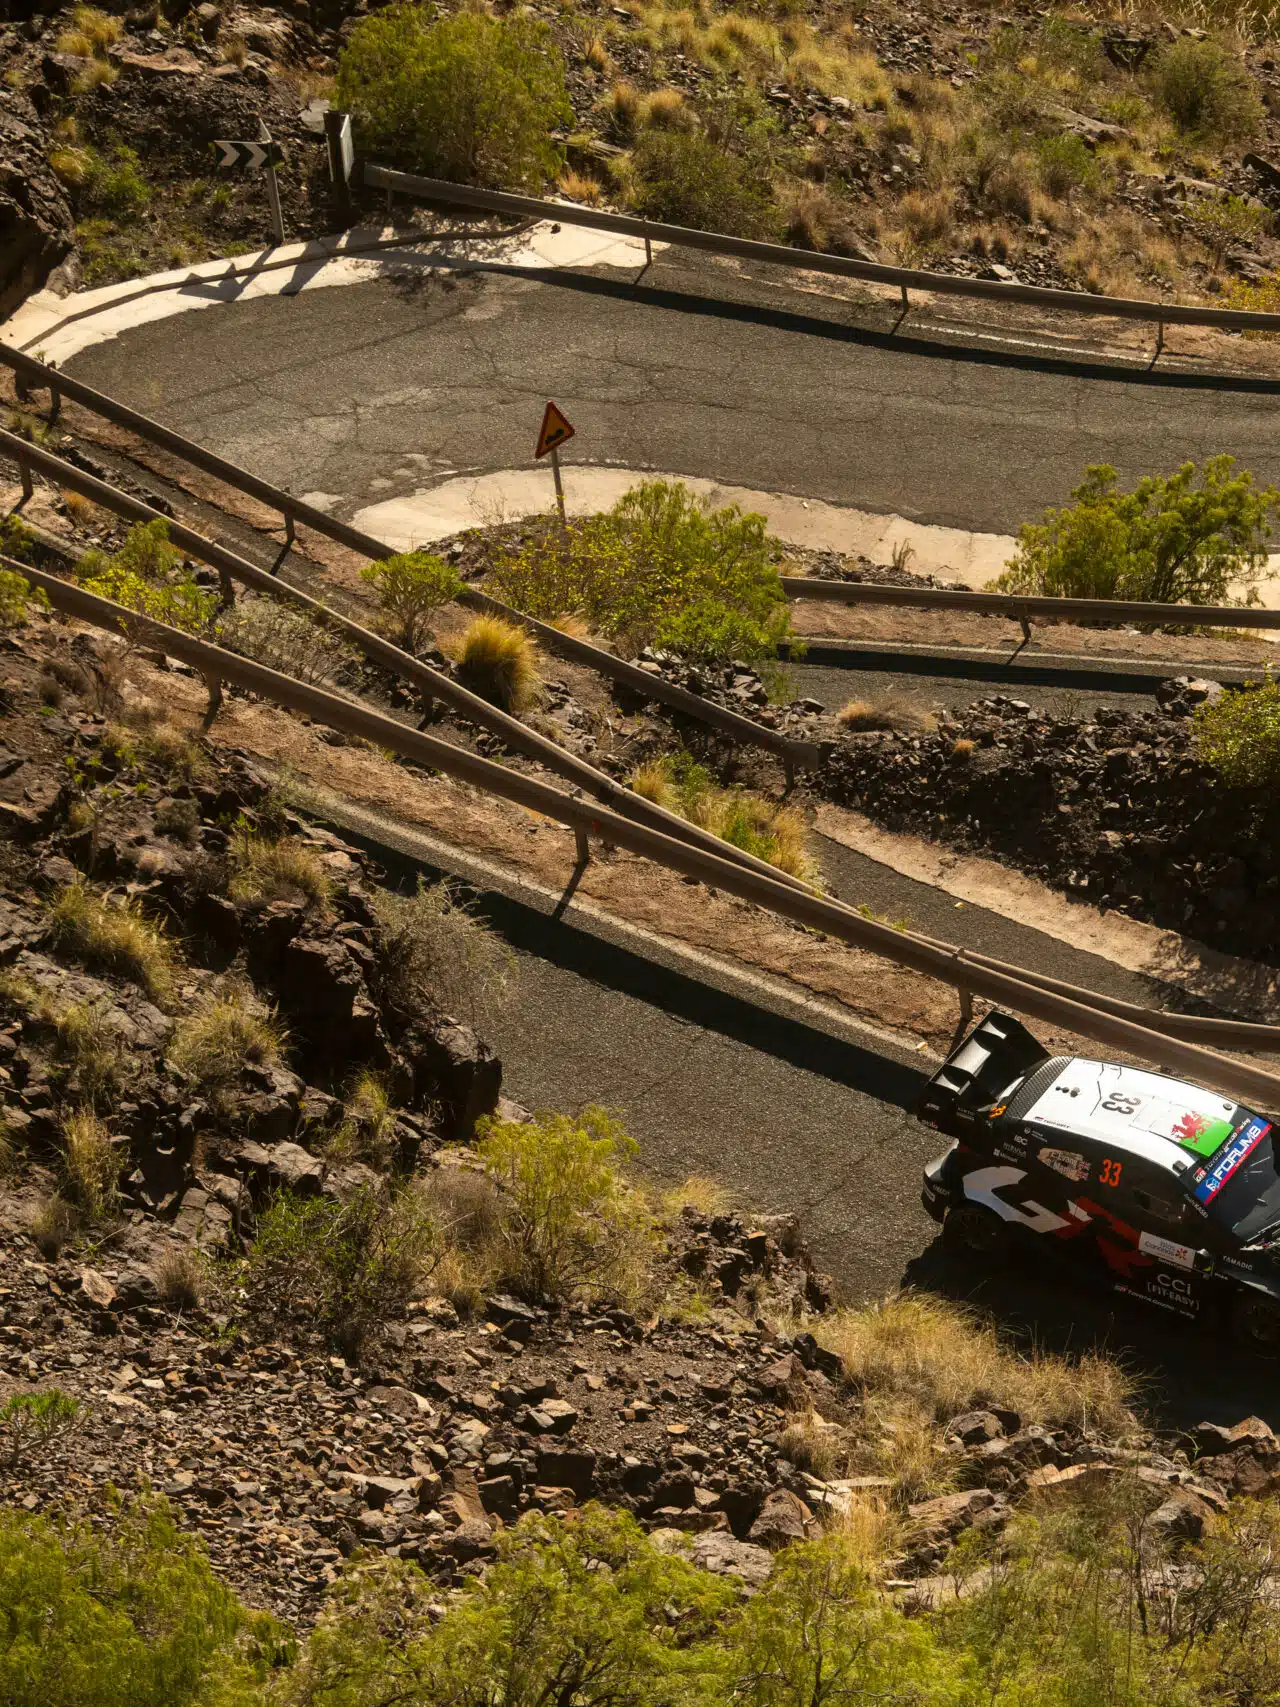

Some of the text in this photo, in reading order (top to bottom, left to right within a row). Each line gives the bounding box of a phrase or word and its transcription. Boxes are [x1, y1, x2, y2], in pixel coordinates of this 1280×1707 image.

[1101, 1092, 1141, 1116] 33
[1212, 1125, 1263, 1181] FORUM8
[1099, 1159, 1123, 1187] 33
[1223, 1255, 1253, 1271] TAMADIC
